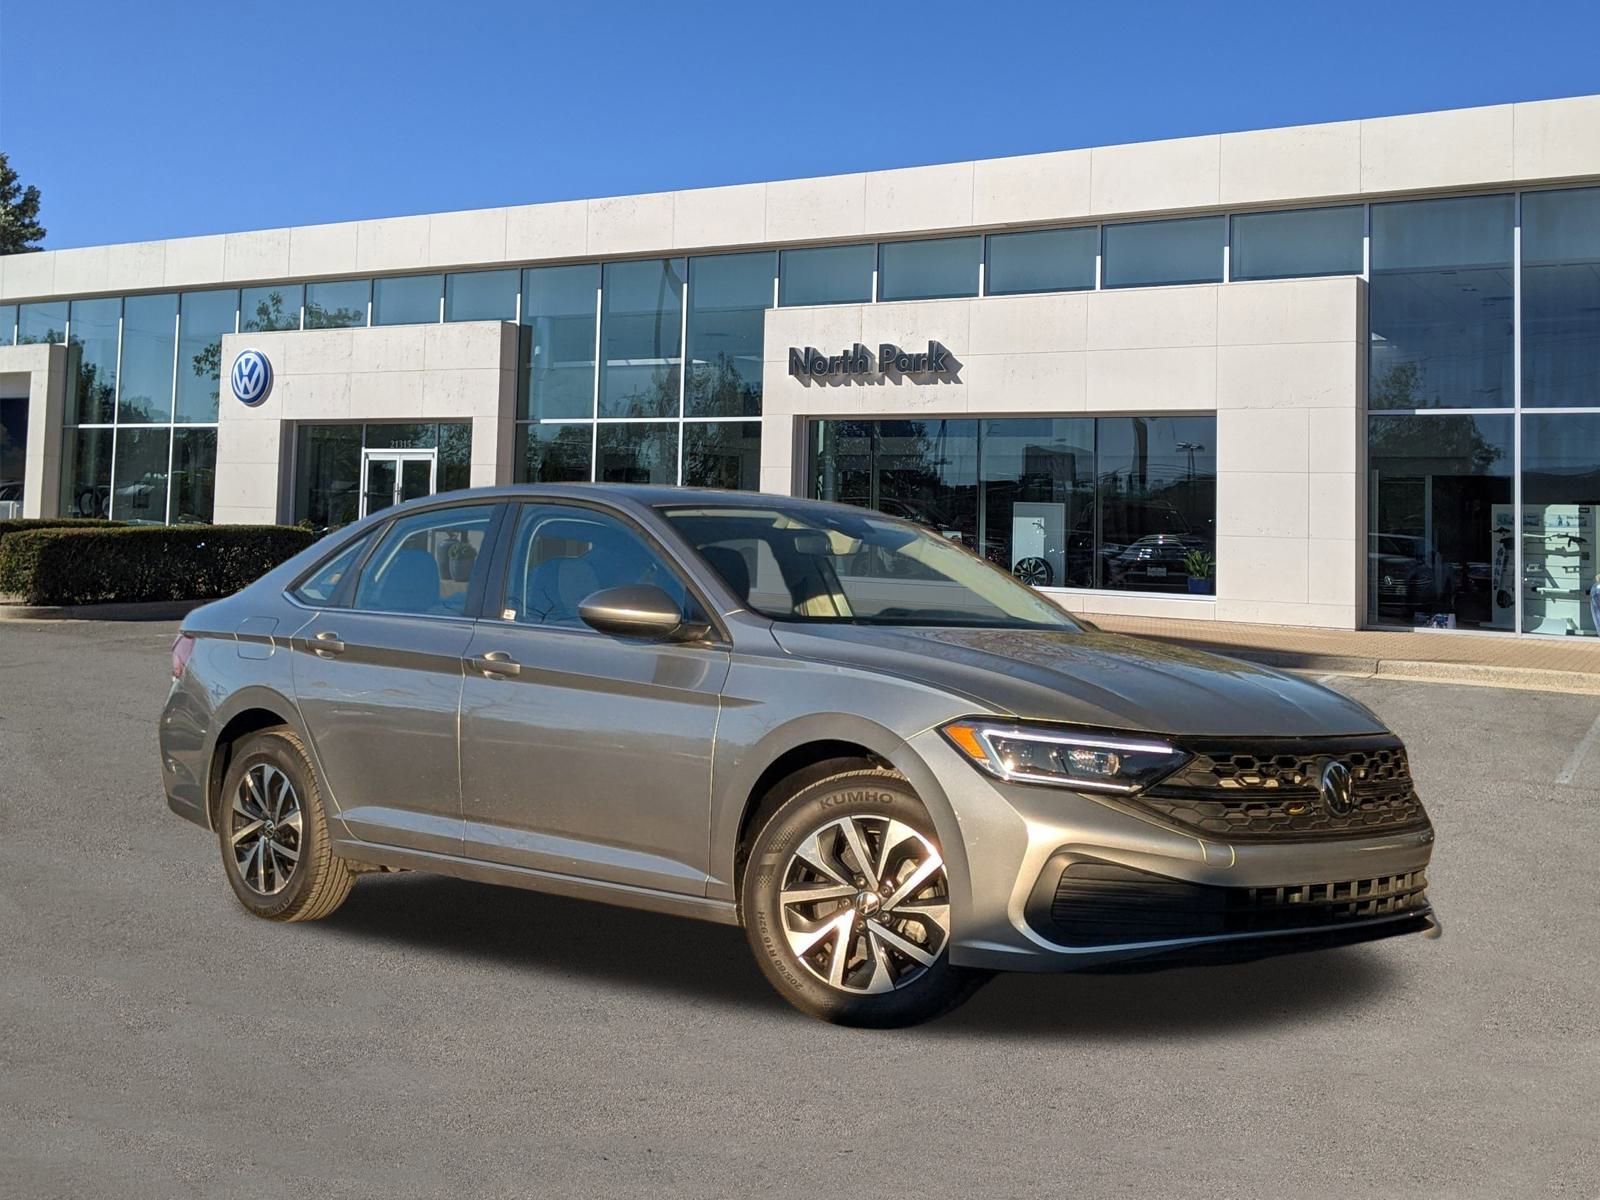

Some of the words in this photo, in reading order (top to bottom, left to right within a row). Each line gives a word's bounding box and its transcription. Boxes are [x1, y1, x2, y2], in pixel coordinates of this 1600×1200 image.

[788, 343, 870, 376] North
[878, 340, 948, 373] Park
[820, 791, 893, 810] KUMHO
